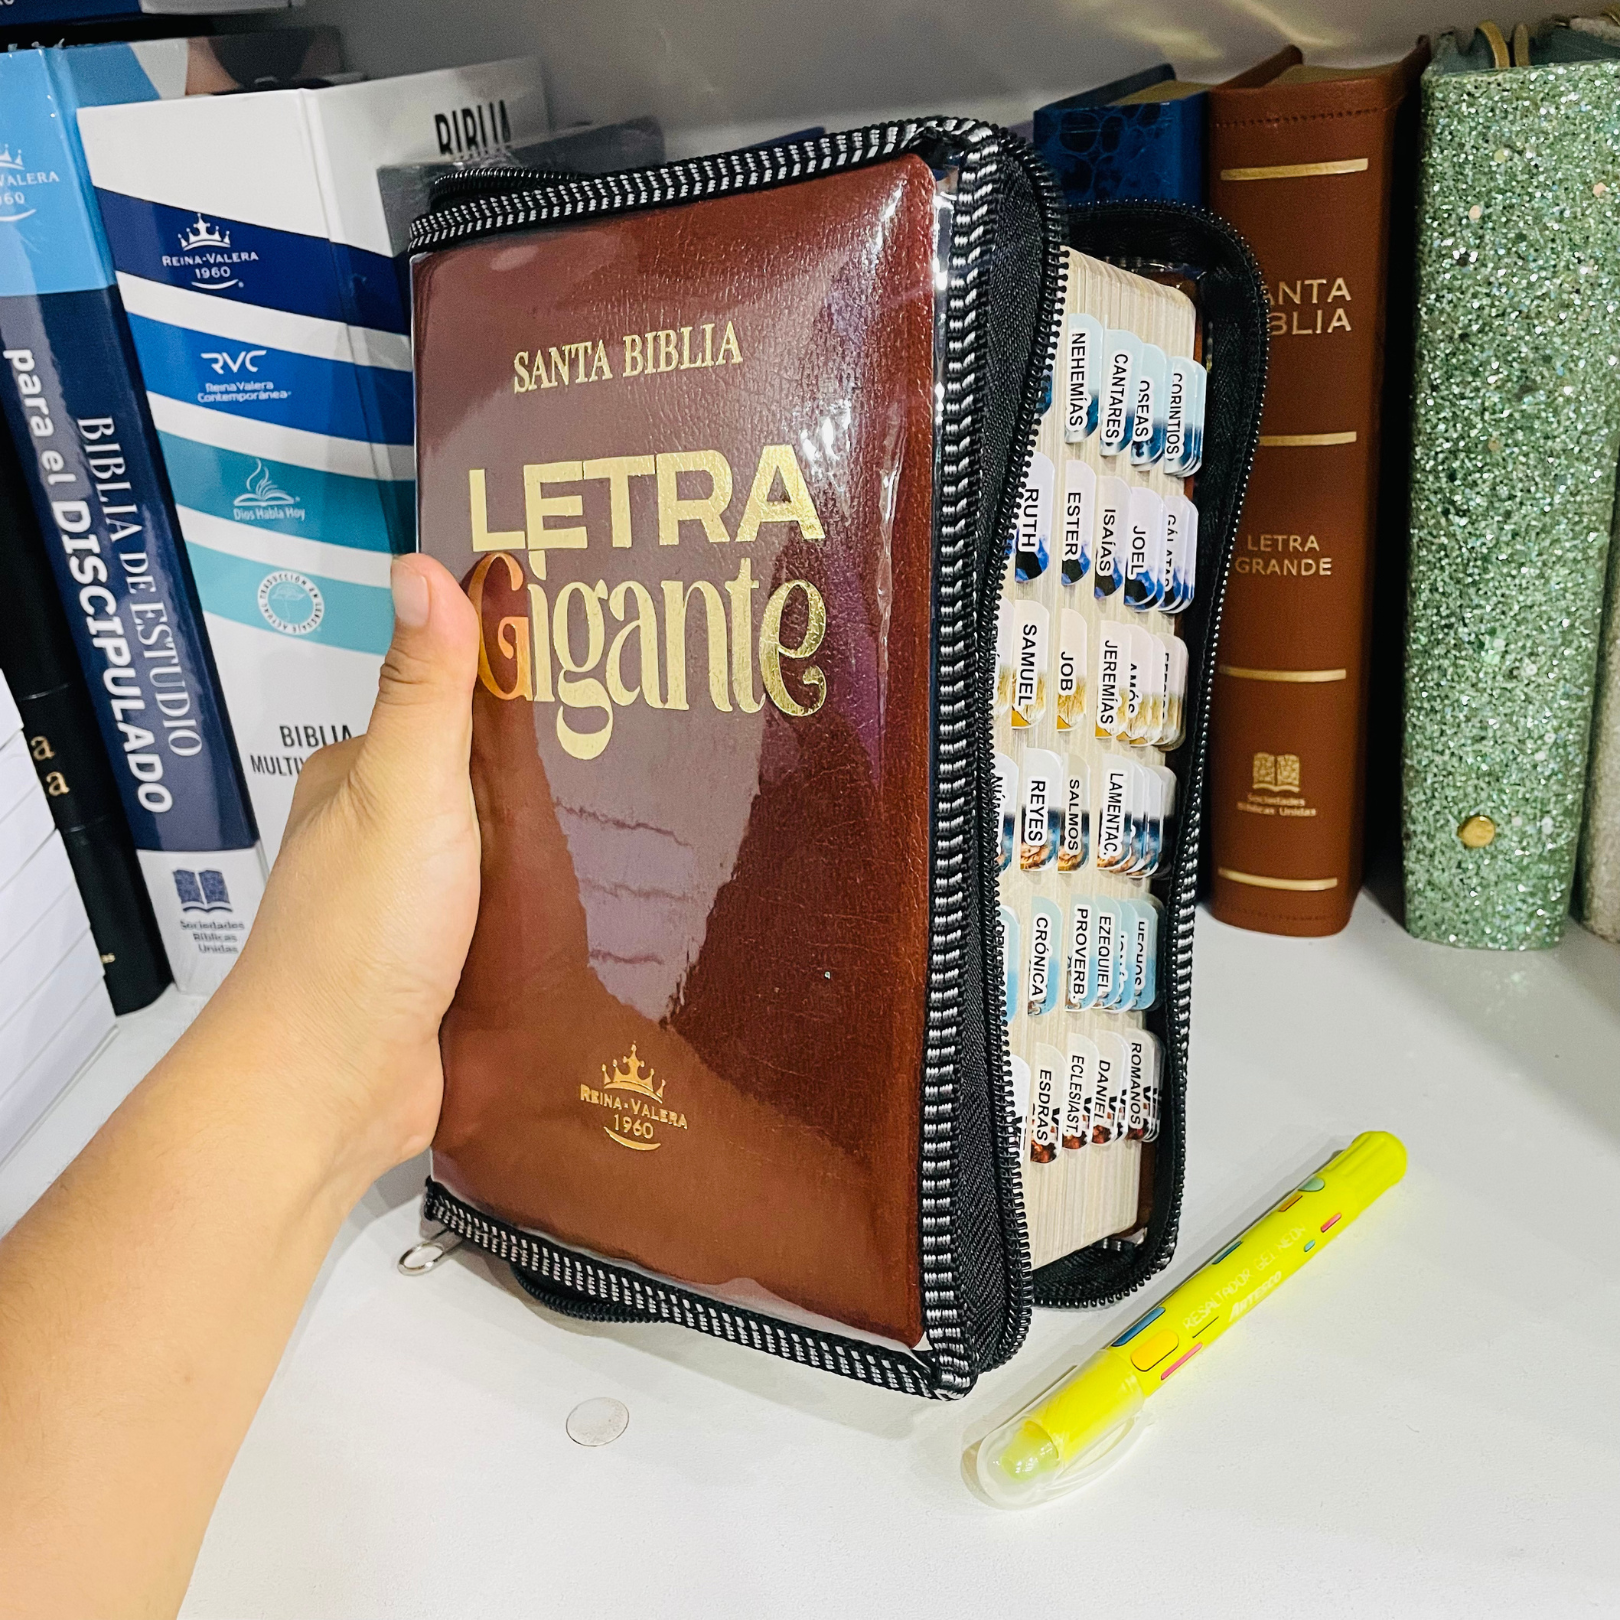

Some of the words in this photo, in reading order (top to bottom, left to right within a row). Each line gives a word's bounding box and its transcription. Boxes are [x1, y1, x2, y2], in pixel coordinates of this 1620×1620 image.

[0, 191, 25, 206] 60
[195, 266, 231, 279] 1960
[1267, 308, 1353, 336] BLIA
[201, 349, 267, 374] RVC
[236, 380, 274, 391] Valera
[513, 340, 613, 395] SANTA
[622, 320, 744, 379] BIBLIA
[1069, 332, 1088, 427] NEHEMÍAS
[3, 349, 54, 437] para
[1106, 353, 1129, 439] CANTARES
[1134, 380, 1150, 437] OSEAS
[1166, 372, 1183, 456] CORINTIOS
[41, 450, 76, 486] el
[77, 415, 143, 542] BIBLIA
[469, 444, 826, 552] LETRA
[233, 508, 255, 521] Dios
[255, 506, 284, 520] Habla
[285, 506, 305, 521] Hoy
[1021, 488, 1039, 547] RUTH
[1065, 492, 1081, 556] ESTER
[1100, 508, 1116, 572] ISAÍAS
[1247, 534, 1320, 552] LETRA
[119, 552, 156, 594] DE
[1130, 525, 1146, 576] JOEL
[1235, 557, 1332, 576] GRANDE
[51, 500, 173, 813] DISCIPULADO
[130, 601, 202, 757] ESTUDIO
[468, 550, 827, 760] Gigante
[1018, 624, 1037, 706] SAMUEL
[1060, 651, 1074, 691] JOB
[1100, 640, 1118, 724] JEREMÍAS
[280, 724, 353, 748] BIBLIA
[1028, 780, 1046, 842] REYES
[1068, 778, 1080, 851] SALMOS
[1102, 772, 1124, 856] LAMENTAC.
[1032, 916, 1051, 997] CRÓNICA
[1072, 908, 1089, 999] PROVERB.
[1036, 1069, 1051, 1142] ESDRAS
[1066, 1055, 1085, 1134] ECLESIAST.
[1094, 1059, 1111, 1120] DANIEL
[1129, 1042, 1142, 1126] ROMANOS
[614, 1113, 654, 1139] 1960
[1183, 1268, 1254, 1330] RESALTADOR
[1253, 1249, 1277, 1272] GEL
[1277, 1223, 1306, 1252] NEON
